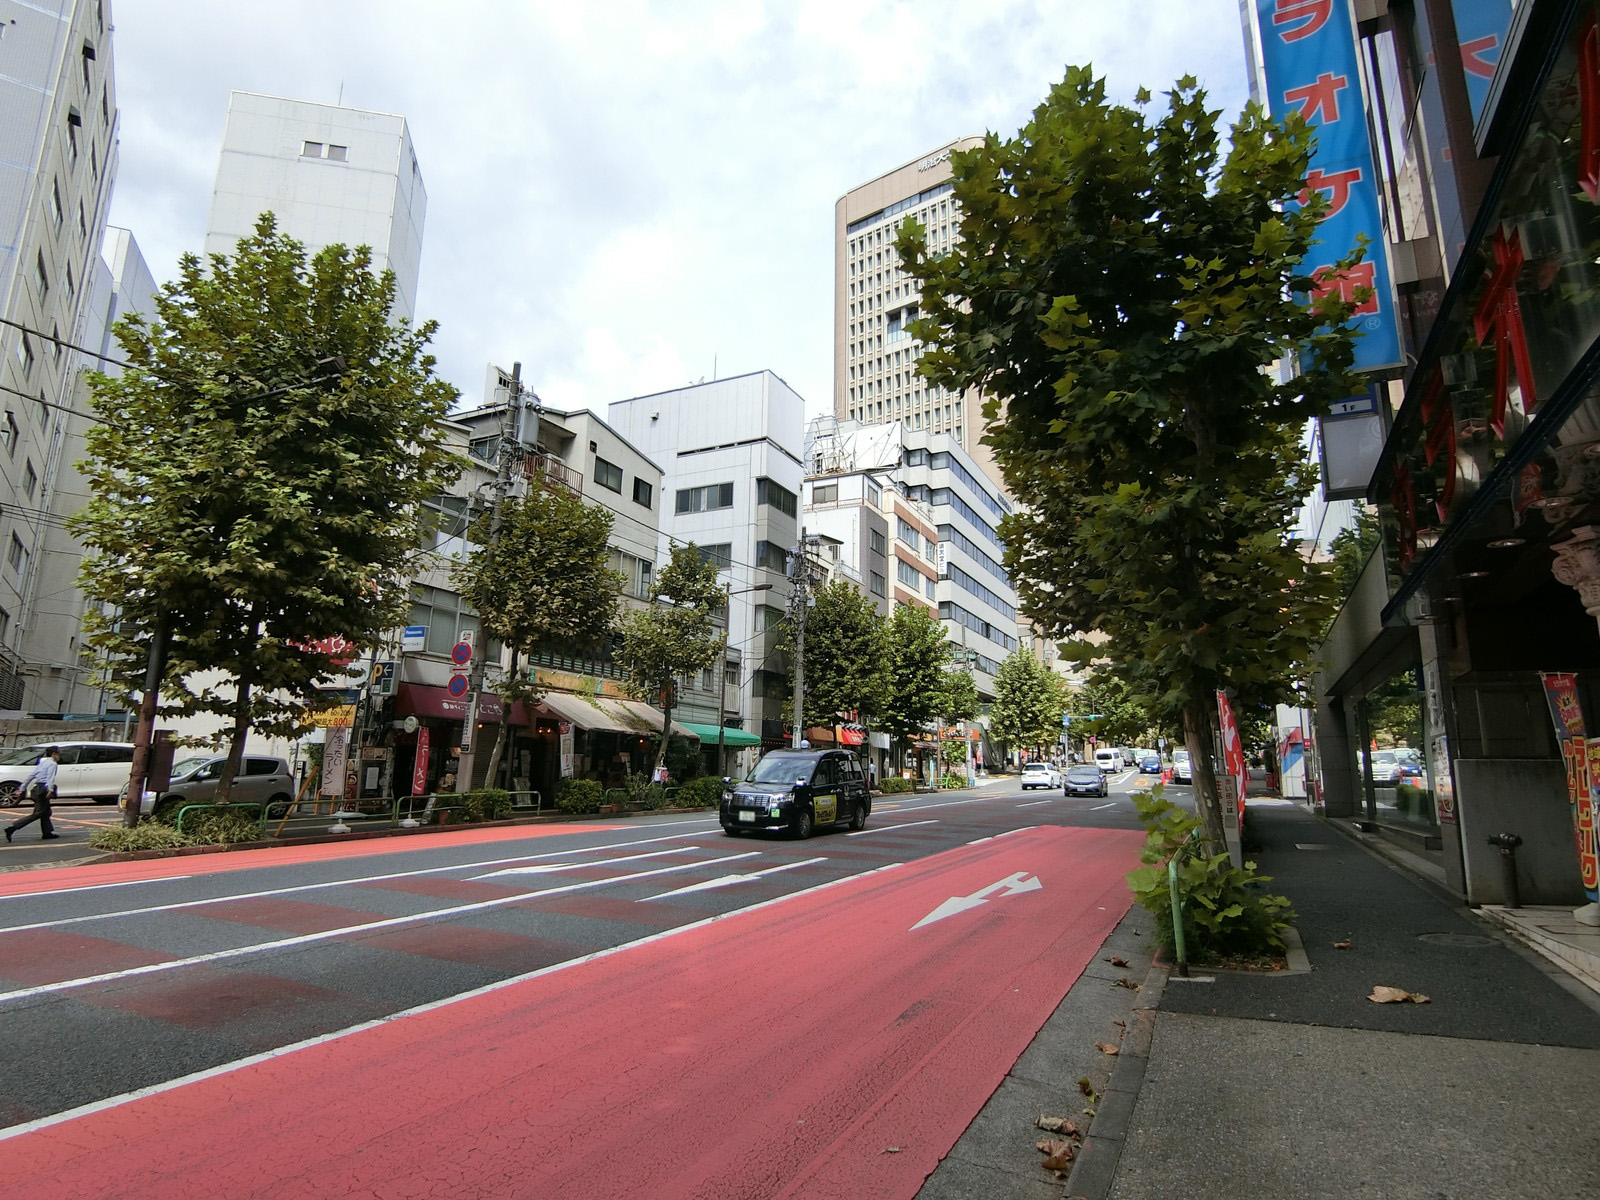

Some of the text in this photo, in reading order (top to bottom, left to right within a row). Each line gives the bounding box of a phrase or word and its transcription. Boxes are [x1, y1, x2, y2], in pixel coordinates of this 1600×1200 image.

[371, 664, 383, 685] P
[324, 752, 334, 785] ラーメン
